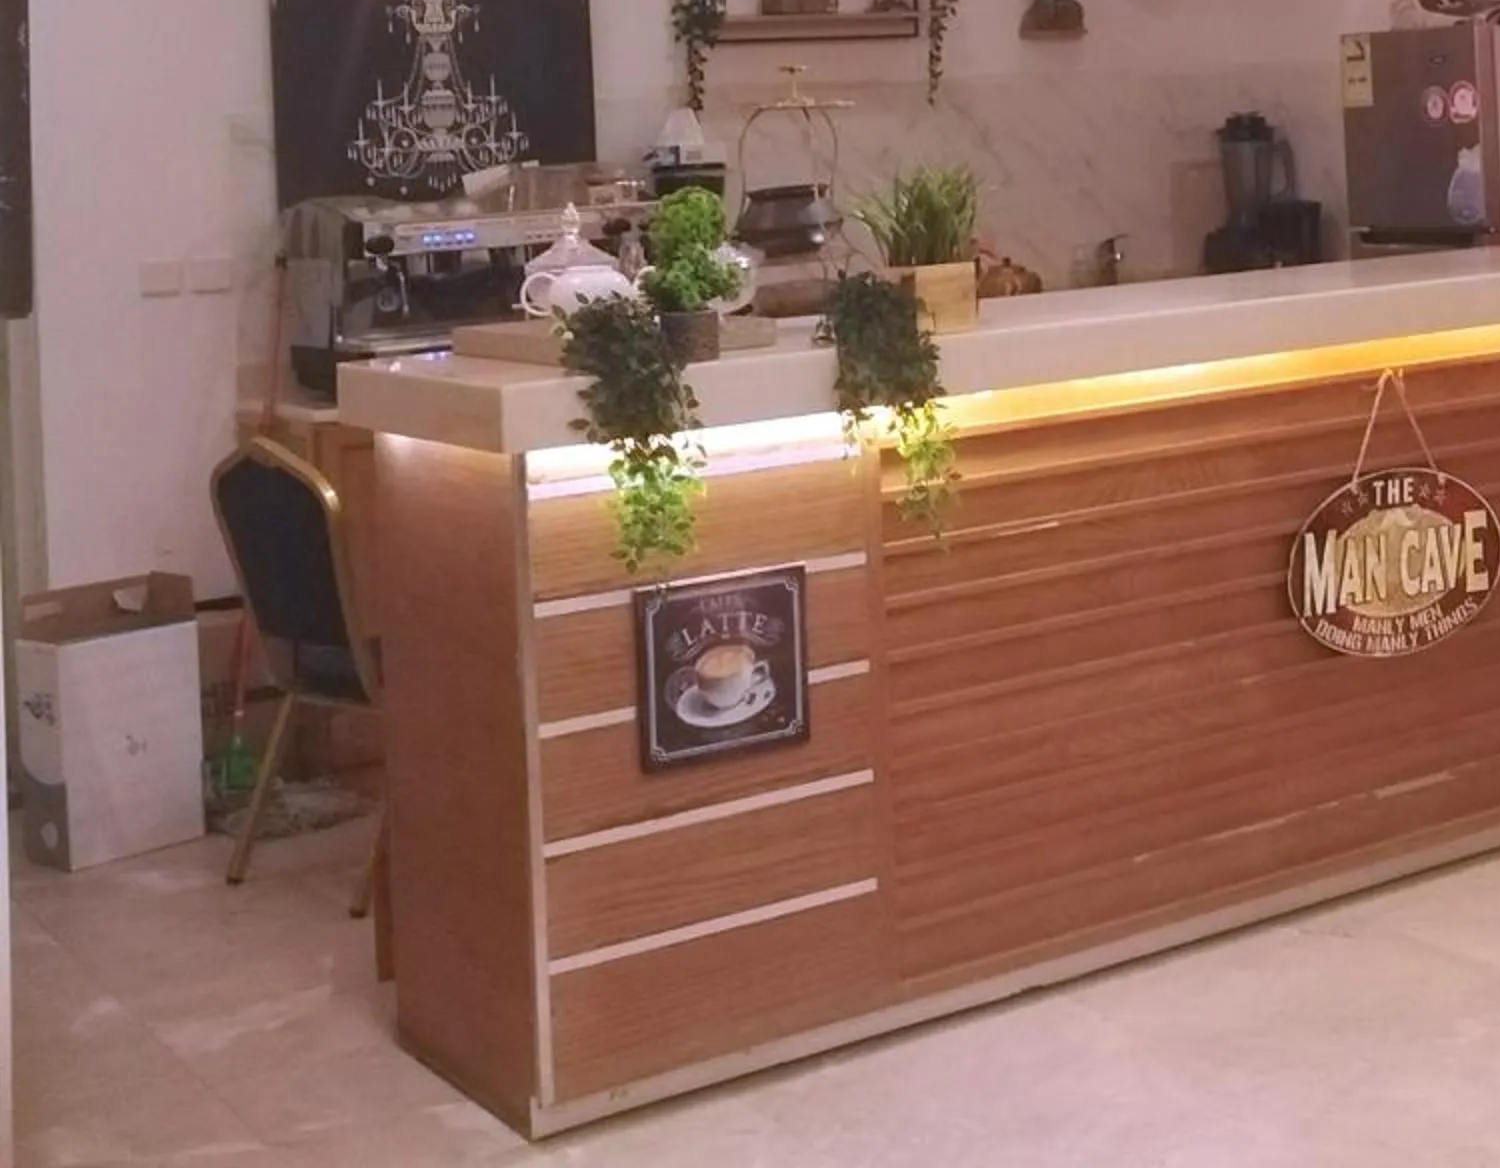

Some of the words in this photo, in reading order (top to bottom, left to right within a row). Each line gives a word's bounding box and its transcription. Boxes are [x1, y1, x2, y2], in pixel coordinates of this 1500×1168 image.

[1372, 477, 1415, 506] THE
[1303, 529, 1387, 617] MAN
[1401, 509, 1489, 597] CAVE
[682, 610, 769, 646] LATTE
[1315, 618, 1363, 651] DOING
[1365, 631, 1419, 653] MANLY
[1423, 595, 1479, 641] THINGS
[1352, 615, 1406, 635] MANLY
[1409, 602, 1444, 631] MEN
